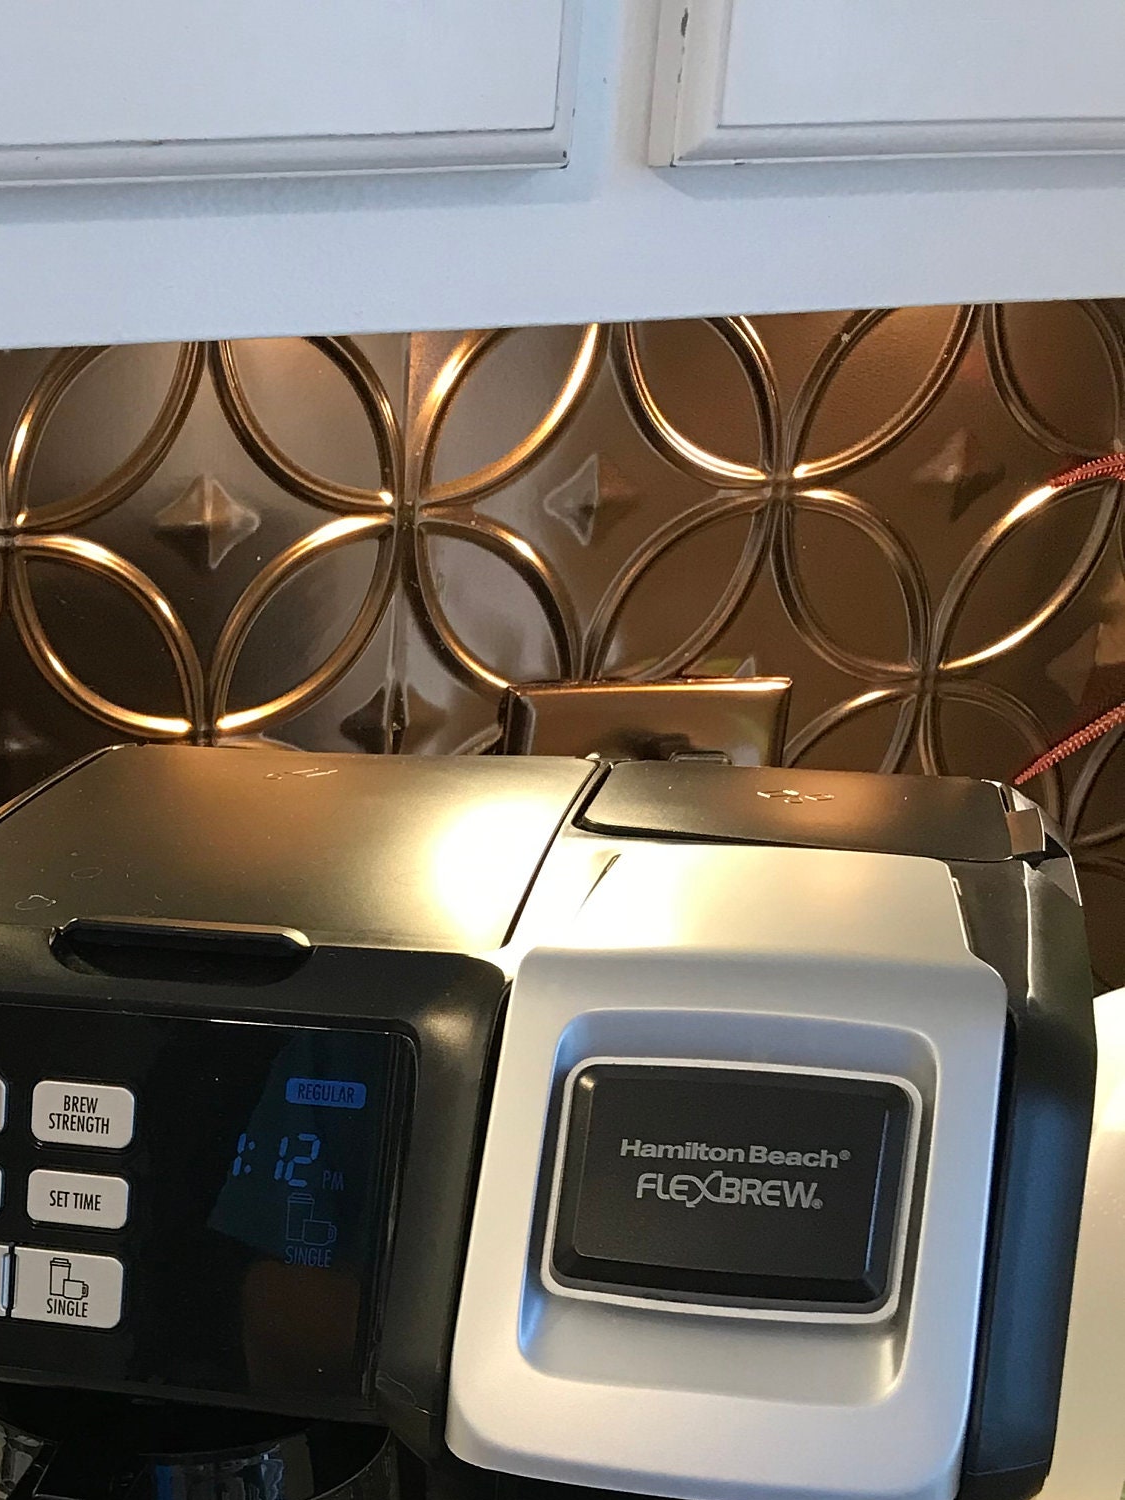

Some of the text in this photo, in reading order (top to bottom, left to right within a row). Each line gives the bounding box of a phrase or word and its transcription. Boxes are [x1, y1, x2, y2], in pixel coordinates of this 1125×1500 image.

[298, 1083, 354, 1103] REGULAR
[63, 1095, 98, 1114] BREW
[48, 1113, 110, 1135] STRENGTH
[620, 1138, 745, 1163] Hamilton
[232, 1133, 345, 1191] 1:12 PM
[49, 1190, 101, 1211] SET TIME
[284, 1246, 332, 1268] SINGLE
[47, 1298, 88, 1318] SINGLE
